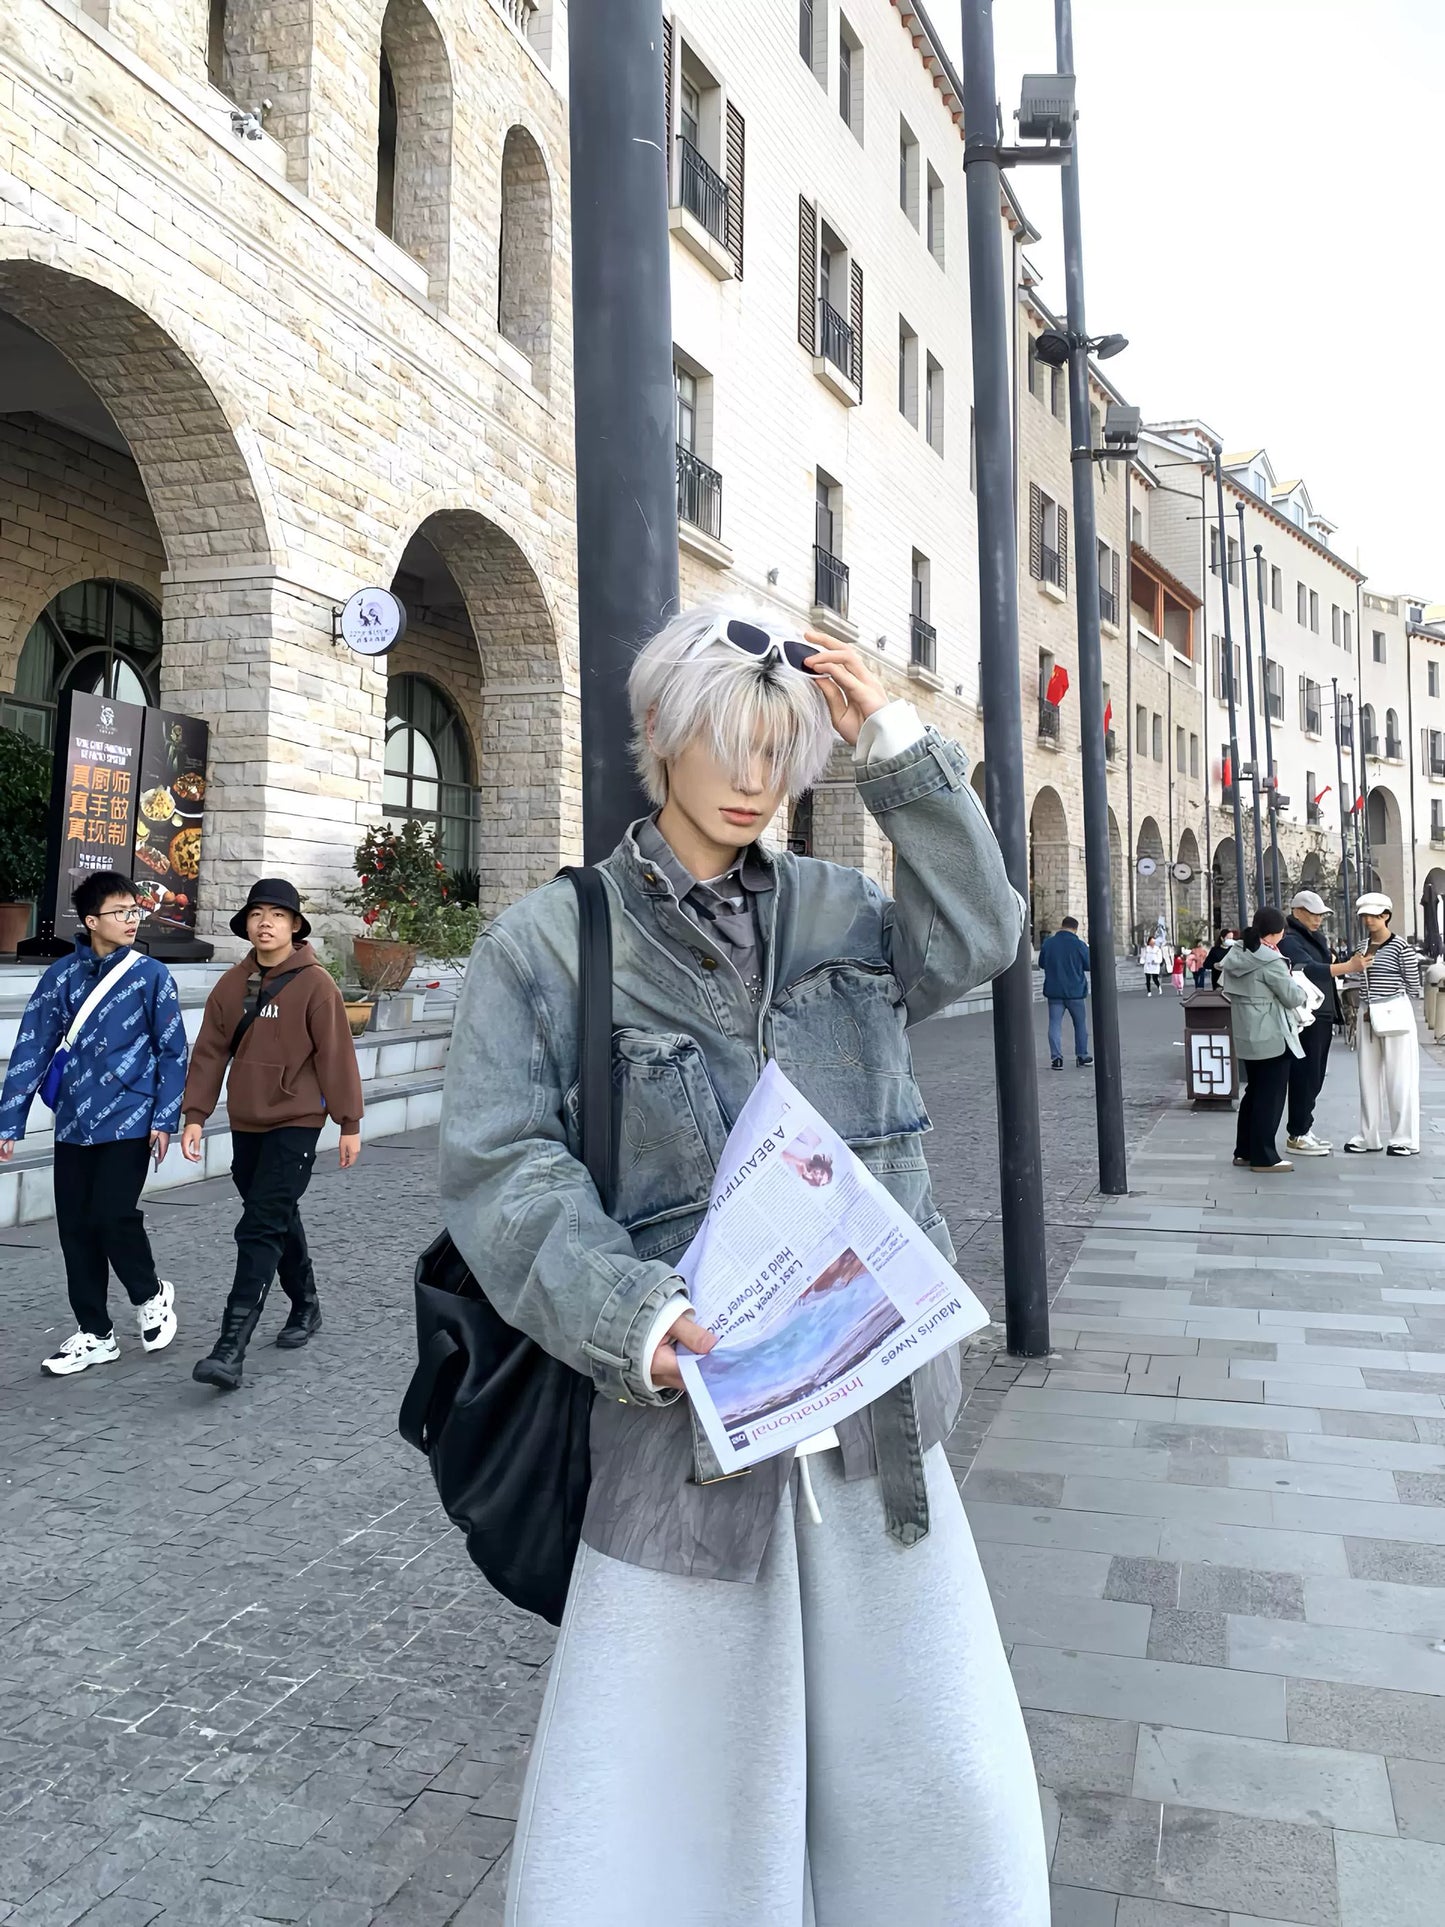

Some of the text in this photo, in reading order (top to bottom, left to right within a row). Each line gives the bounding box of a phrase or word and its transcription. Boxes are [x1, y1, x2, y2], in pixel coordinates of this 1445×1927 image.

[72, 765, 131, 795] 真厨师
[69, 791, 129, 820] 真手做
[67, 817, 127, 846] 真现制
[709, 1125, 785, 1211] A BEAUTIFUL
[767, 1246, 794, 1275] Held
[779, 1259, 803, 1285] Last
[760, 1270, 770, 1281] a
[727, 1278, 764, 1315] Flower
[754, 1283, 781, 1311] week
[881, 1298, 962, 1366] Mauris Nwes
[752, 1376, 864, 1440] International
